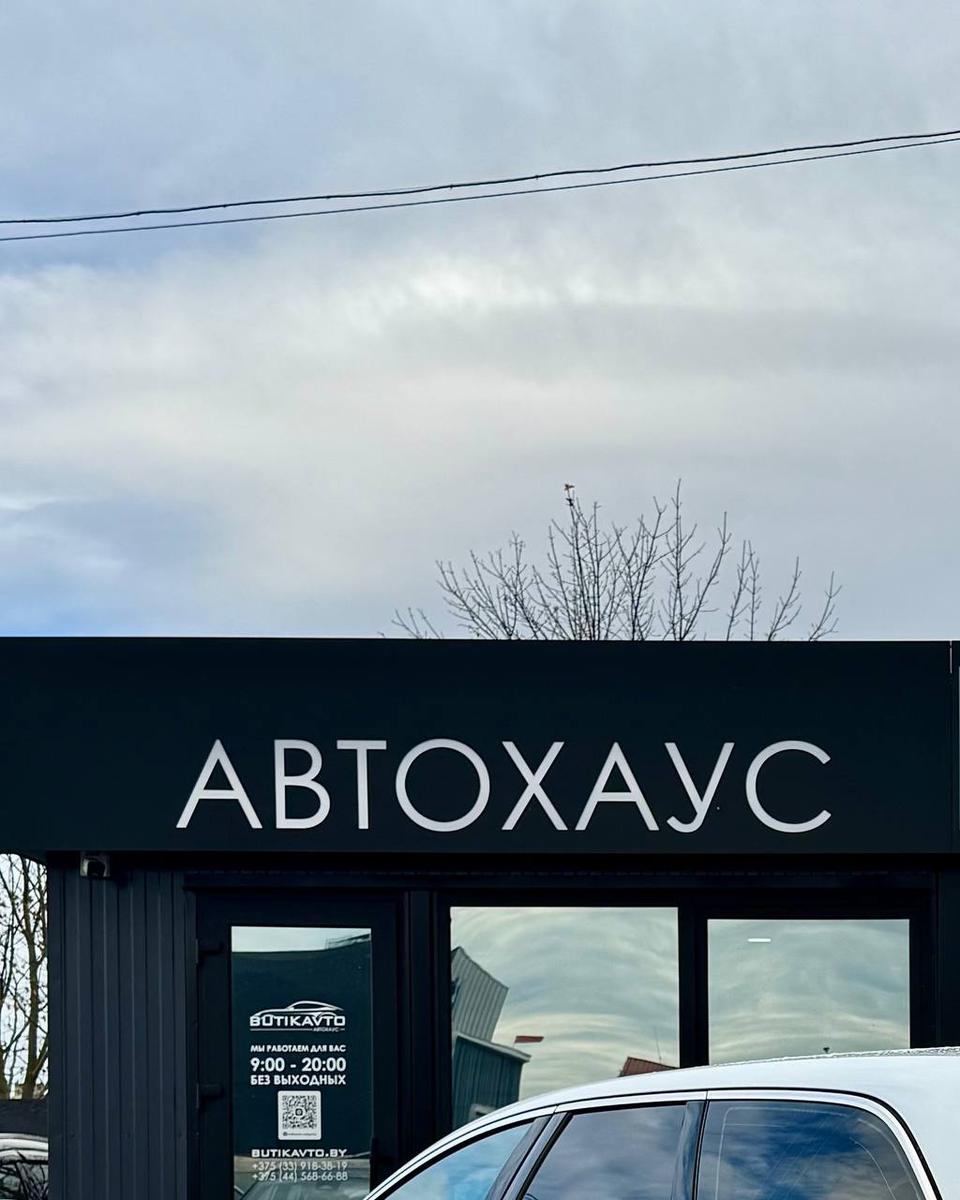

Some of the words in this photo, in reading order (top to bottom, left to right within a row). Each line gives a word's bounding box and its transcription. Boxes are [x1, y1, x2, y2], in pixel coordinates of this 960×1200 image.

[175, 737, 833, 834] АВТОХАУС
[249, 1014, 346, 1027] BUTIKAVTO
[310, 1045, 327, 1053] ДЛЯ
[250, 1057, 285, 1072] 9:00
[301, 1057, 346, 1072] 20:00
[250, 1074, 271, 1085] БЕЗ
[273, 1074, 346, 1086] ВЫХОДНЫХ
[251, 1148, 347, 1158] BUTIKAVTO.BY
[252, 1161, 276, 1171] +375
[279, 1161, 297, 1172] (33)
[300, 1161, 348, 1171] 918-38-19
[252, 1171, 276, 1181] +375
[279, 1171, 297, 1183] (44)
[300, 1171, 348, 1181] 568-66-88
